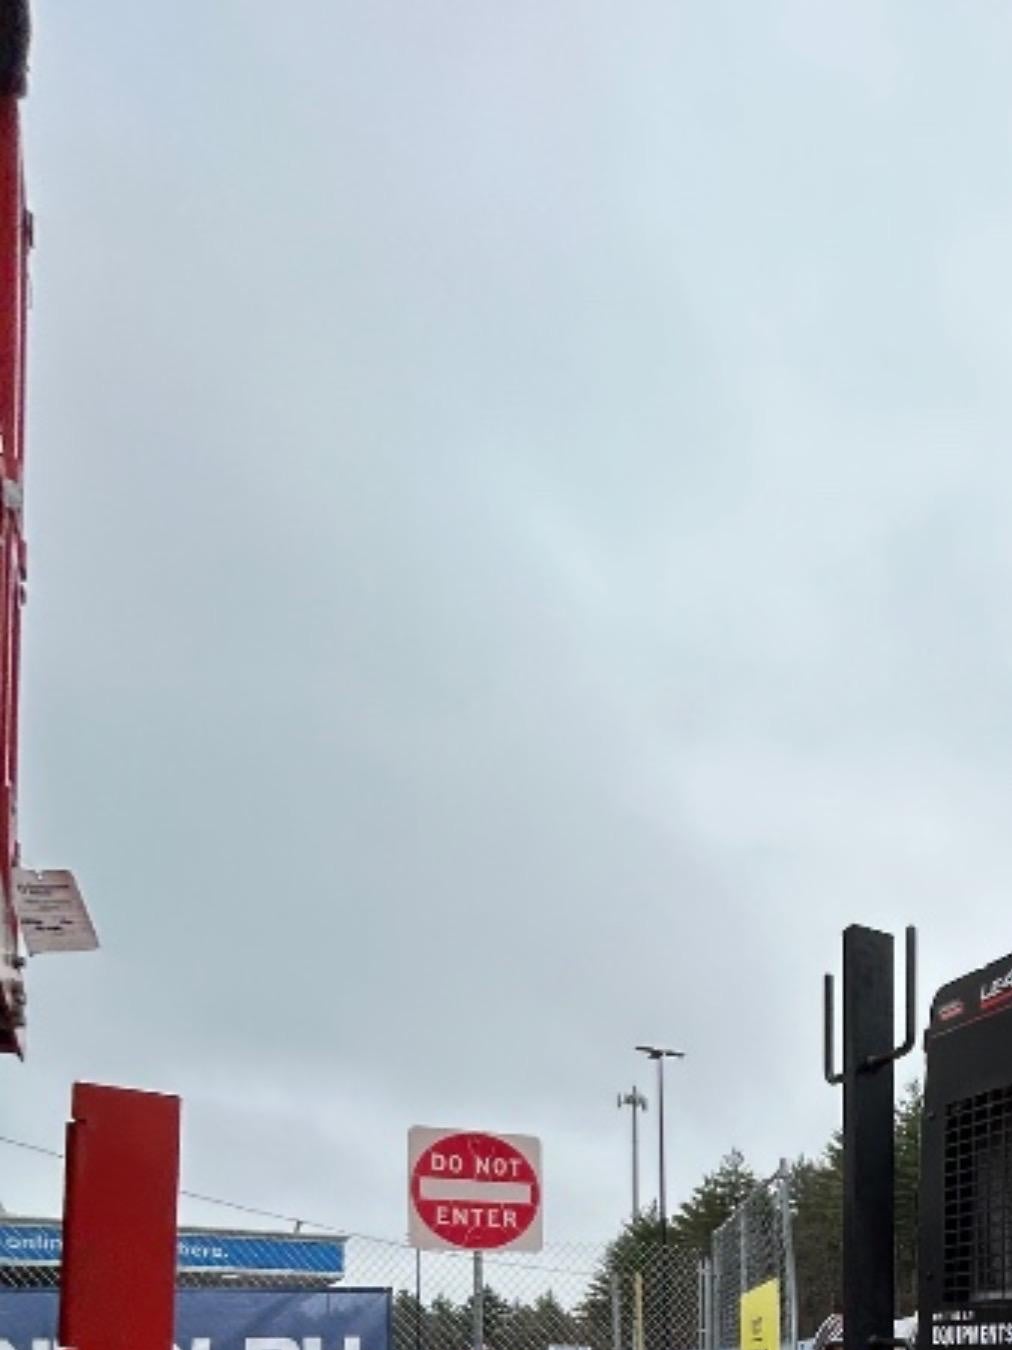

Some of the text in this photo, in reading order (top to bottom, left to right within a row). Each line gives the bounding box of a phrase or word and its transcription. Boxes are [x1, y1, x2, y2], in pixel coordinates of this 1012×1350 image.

[431, 1152, 523, 1177] DO NOT
[436, 1206, 517, 1228] ENTER
